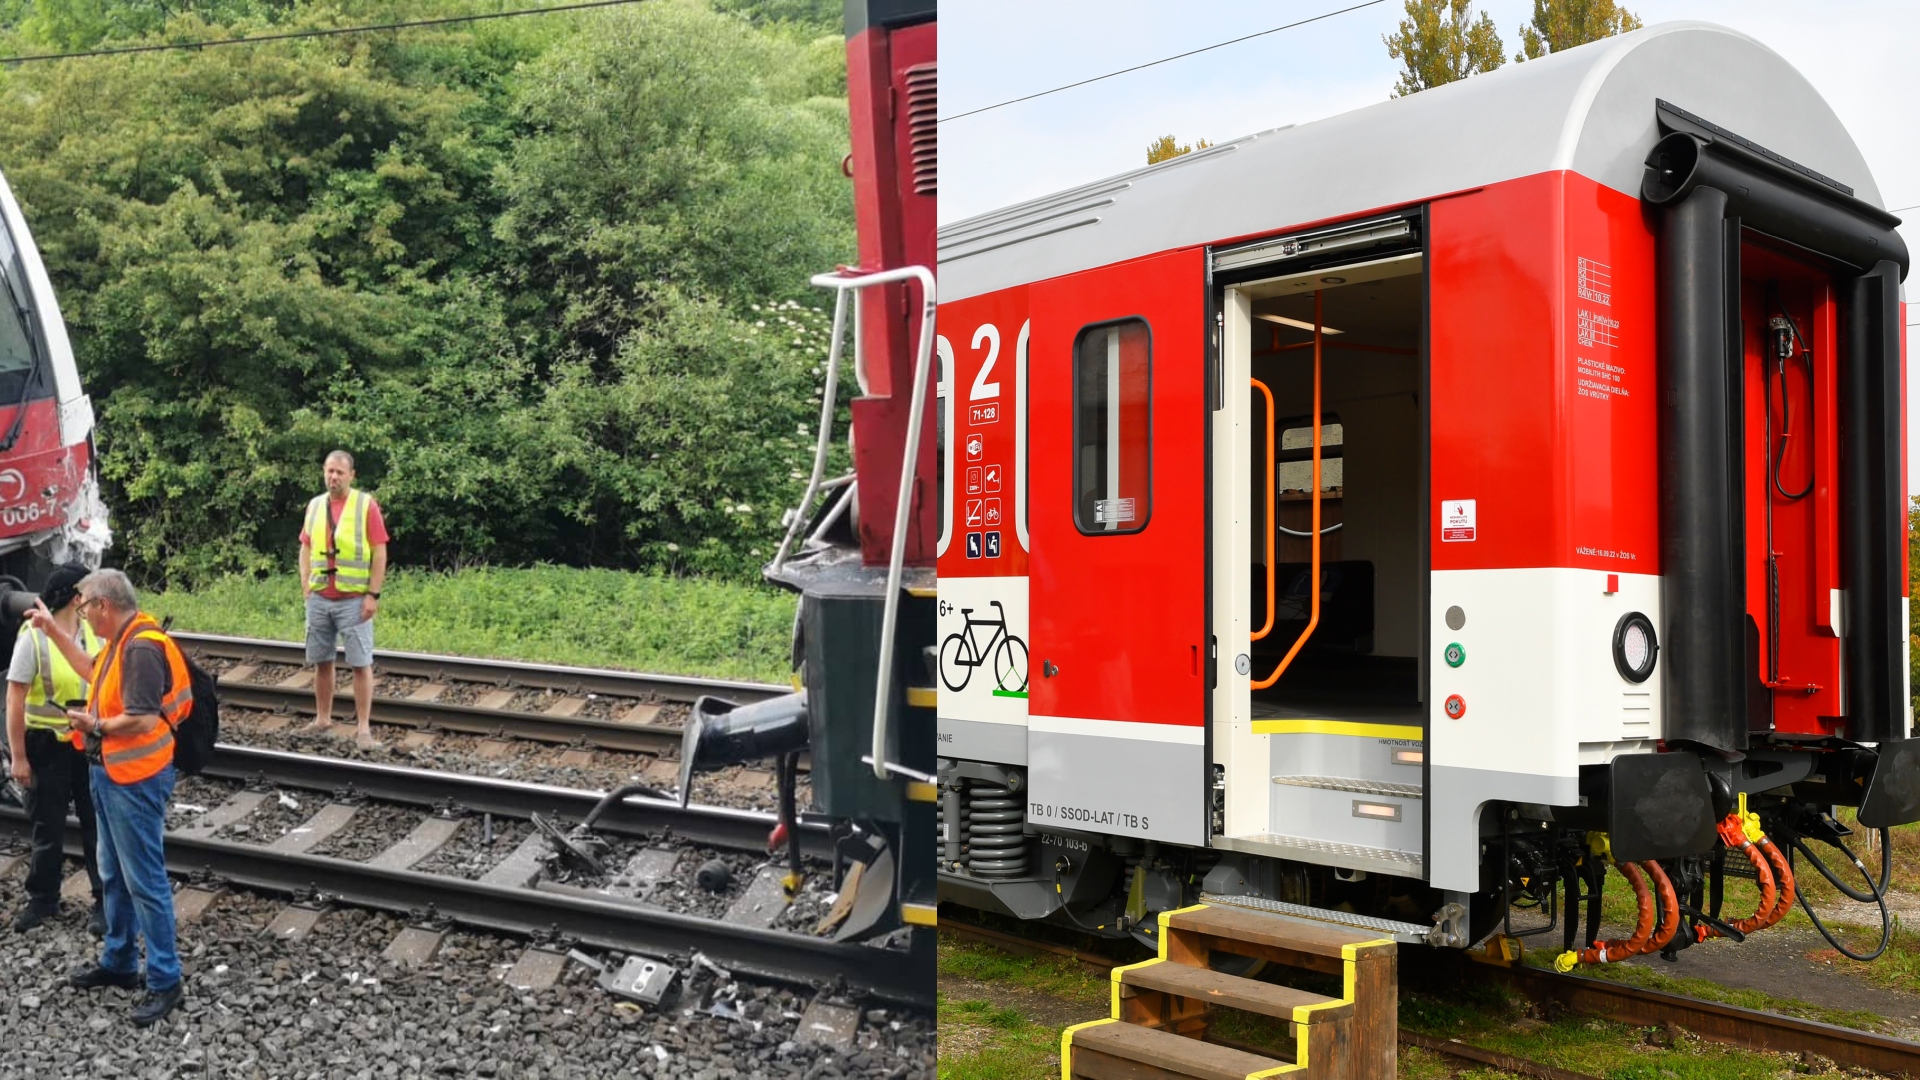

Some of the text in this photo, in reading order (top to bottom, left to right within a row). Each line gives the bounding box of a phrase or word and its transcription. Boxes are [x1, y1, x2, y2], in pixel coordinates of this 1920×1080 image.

[1577, 308, 1589, 319] LAK
[1577, 317, 1589, 329] LAK
[1577, 327, 1589, 338] LAK
[970, 323, 1000, 400] 2
[1577, 356, 1605, 369] PLASTICKÉ
[1577, 366, 1600, 377] MOBILITH
[1601, 371, 1611, 380] SHC
[973, 406, 996, 422] 71-128
[939, 599, 954, 617] 6+
[936, 732, 953, 743] ANIE
[1030, 802, 1044, 816] TB
[1060, 806, 1115, 825] SSOD-LAT
[1123, 813, 1139, 829] TB
[1141, 816, 1149, 830] S
[1041, 833, 1088, 852] 22-70 103-b
